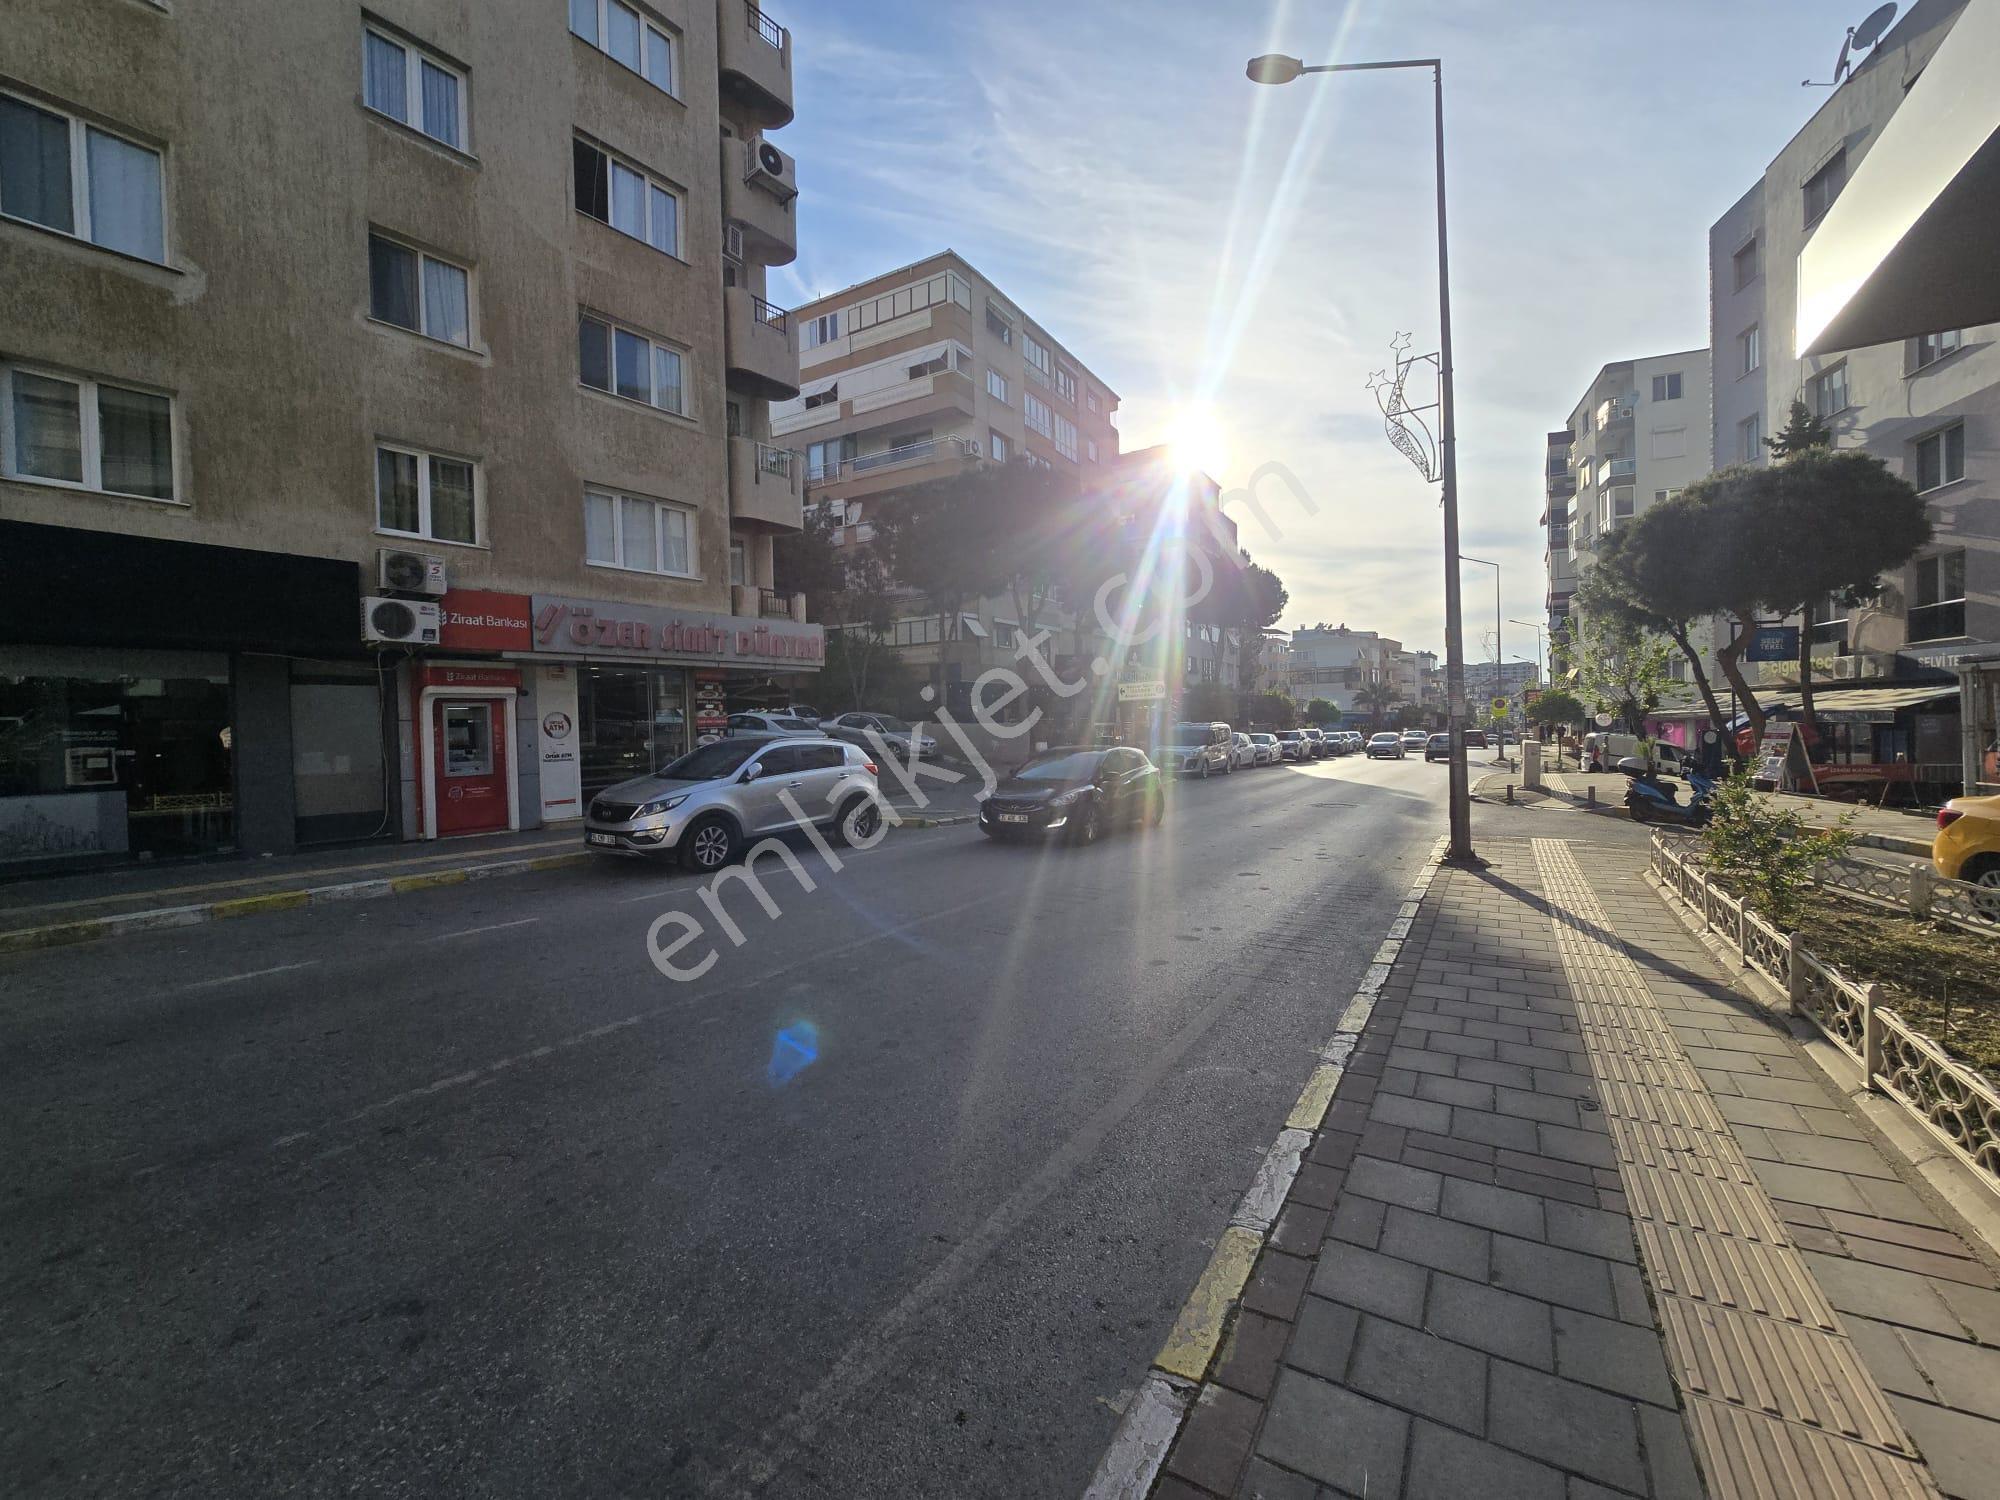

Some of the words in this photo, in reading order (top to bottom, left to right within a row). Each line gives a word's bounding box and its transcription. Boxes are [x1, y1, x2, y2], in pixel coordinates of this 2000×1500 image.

[450, 612, 484, 626] Ziraat
[486, 615, 528, 629] Bankası
[569, 607, 650, 649] ÖZEN
[735, 624, 824, 660] DÜNYASI
[1918, 652, 1946, 669] SELVİ
[1946, 655, 1960, 667] TE
[548, 723, 565, 732] ATM
[545, 752, 560, 760] Ortak
